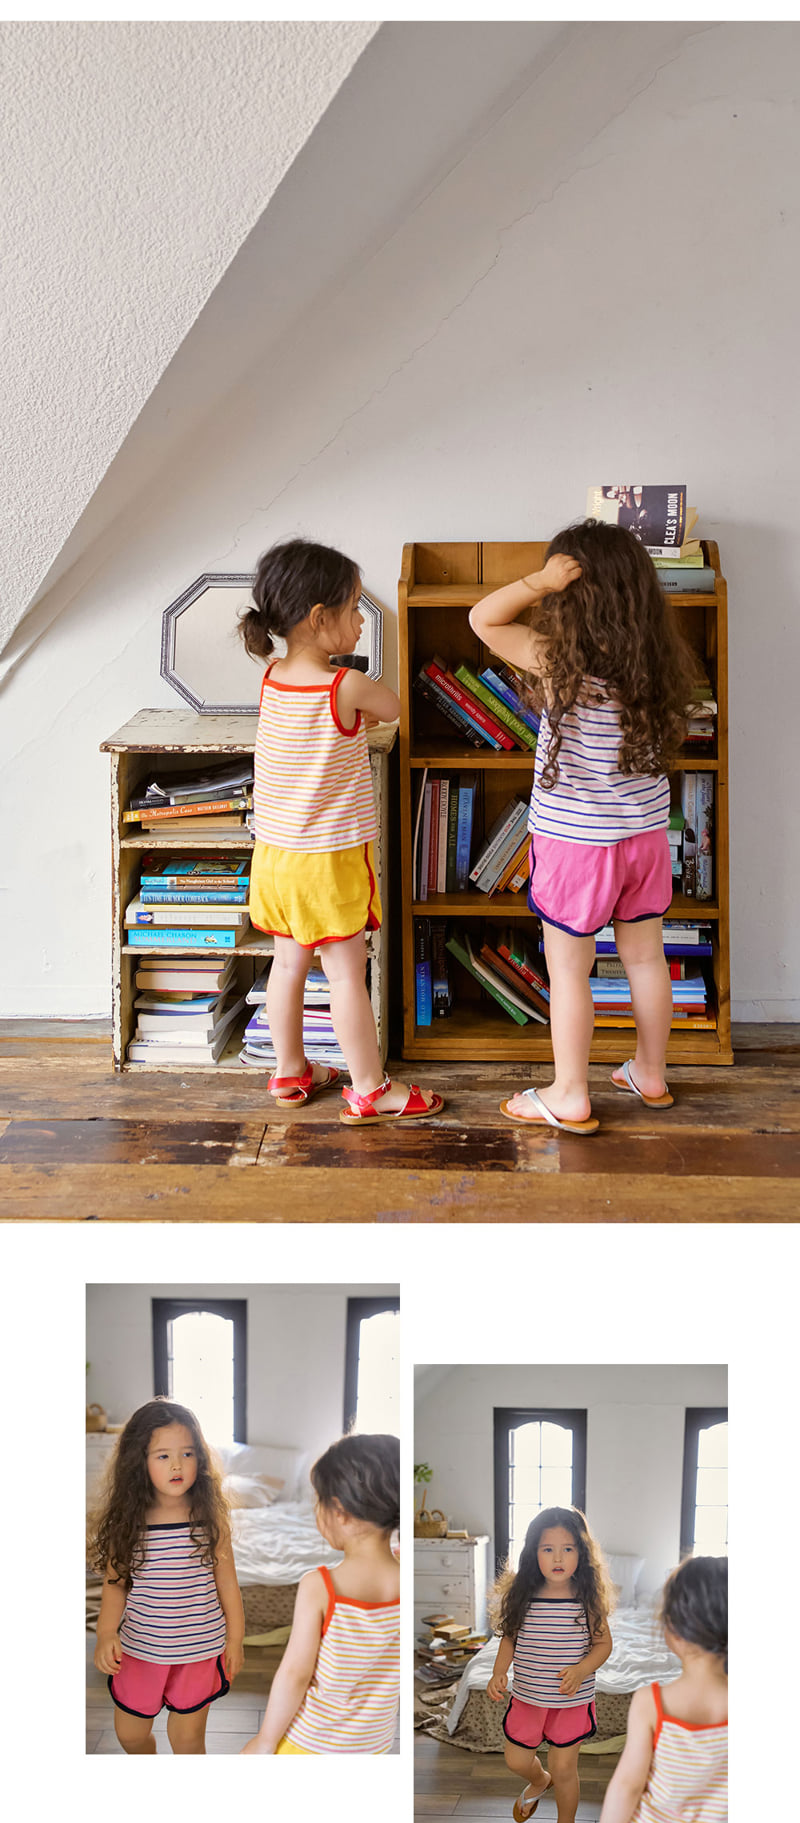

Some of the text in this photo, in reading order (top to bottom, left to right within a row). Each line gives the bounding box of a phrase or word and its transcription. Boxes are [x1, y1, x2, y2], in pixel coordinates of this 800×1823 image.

[667, 492, 679, 517] MOON
[663, 519, 677, 545] CLEA'S
[435, 674, 463, 701] microthrills
[488, 696, 537, 746] Our Good Neighbors
[450, 794, 458, 822] HOMES
[133, 935, 198, 944] SUMMERLAND
